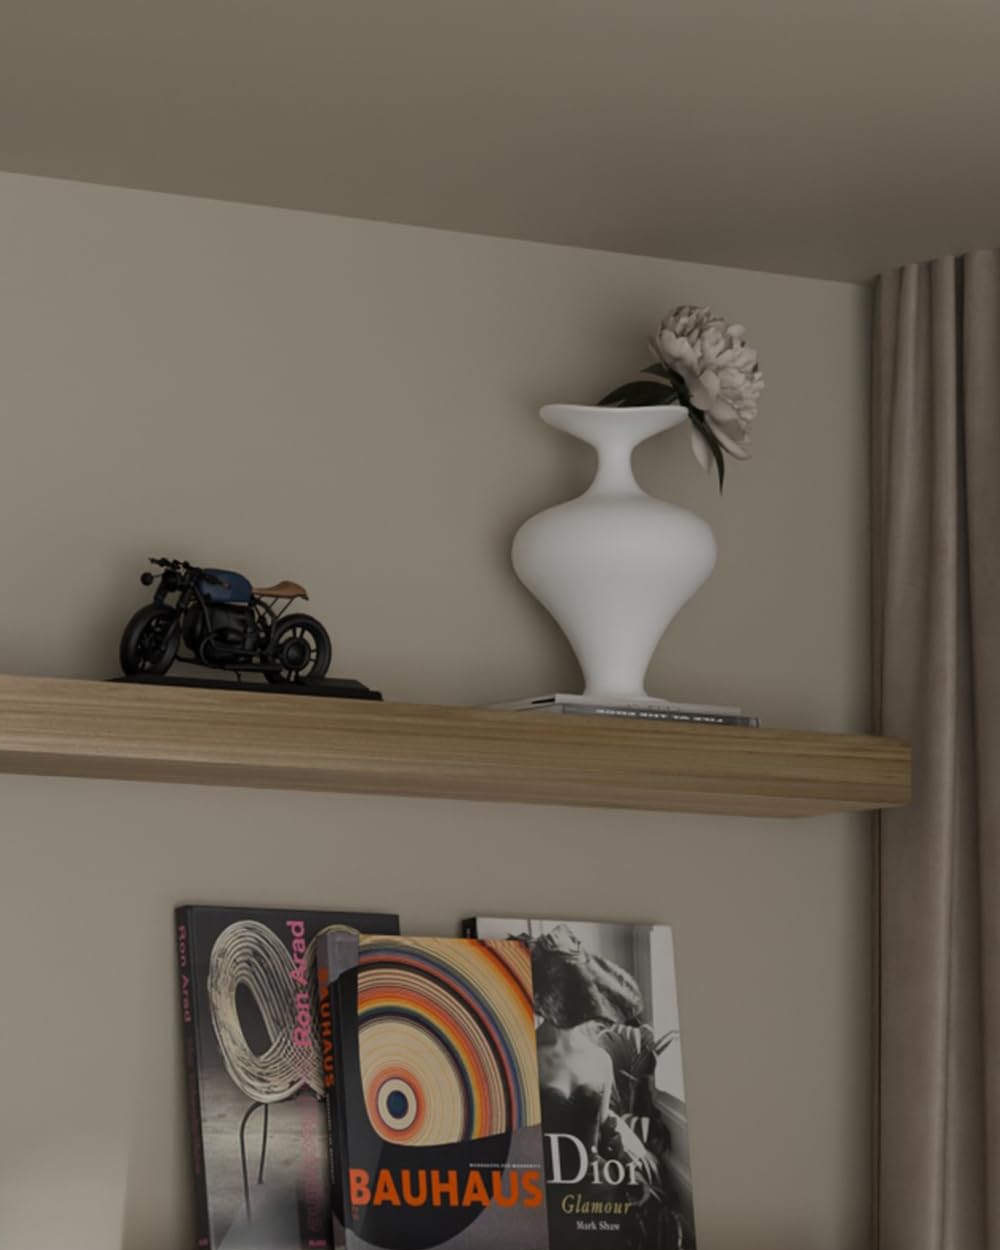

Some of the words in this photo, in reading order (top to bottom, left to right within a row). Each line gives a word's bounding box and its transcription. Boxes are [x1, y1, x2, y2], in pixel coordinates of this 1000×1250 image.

[178, 925, 187, 967] Ron
[285, 919, 307, 985] Arad
[181, 975, 192, 1023] Arad
[291, 992, 312, 1047] Ron
[317, 967, 335, 1088] BAUHAUS
[544, 1132, 642, 1185] Dior
[348, 1167, 544, 1208] BAUHAUS
[561, 1193, 632, 1215] Glamour
[576, 1221, 597, 1231] Mark
[598, 1221, 621, 1231] Shaw
